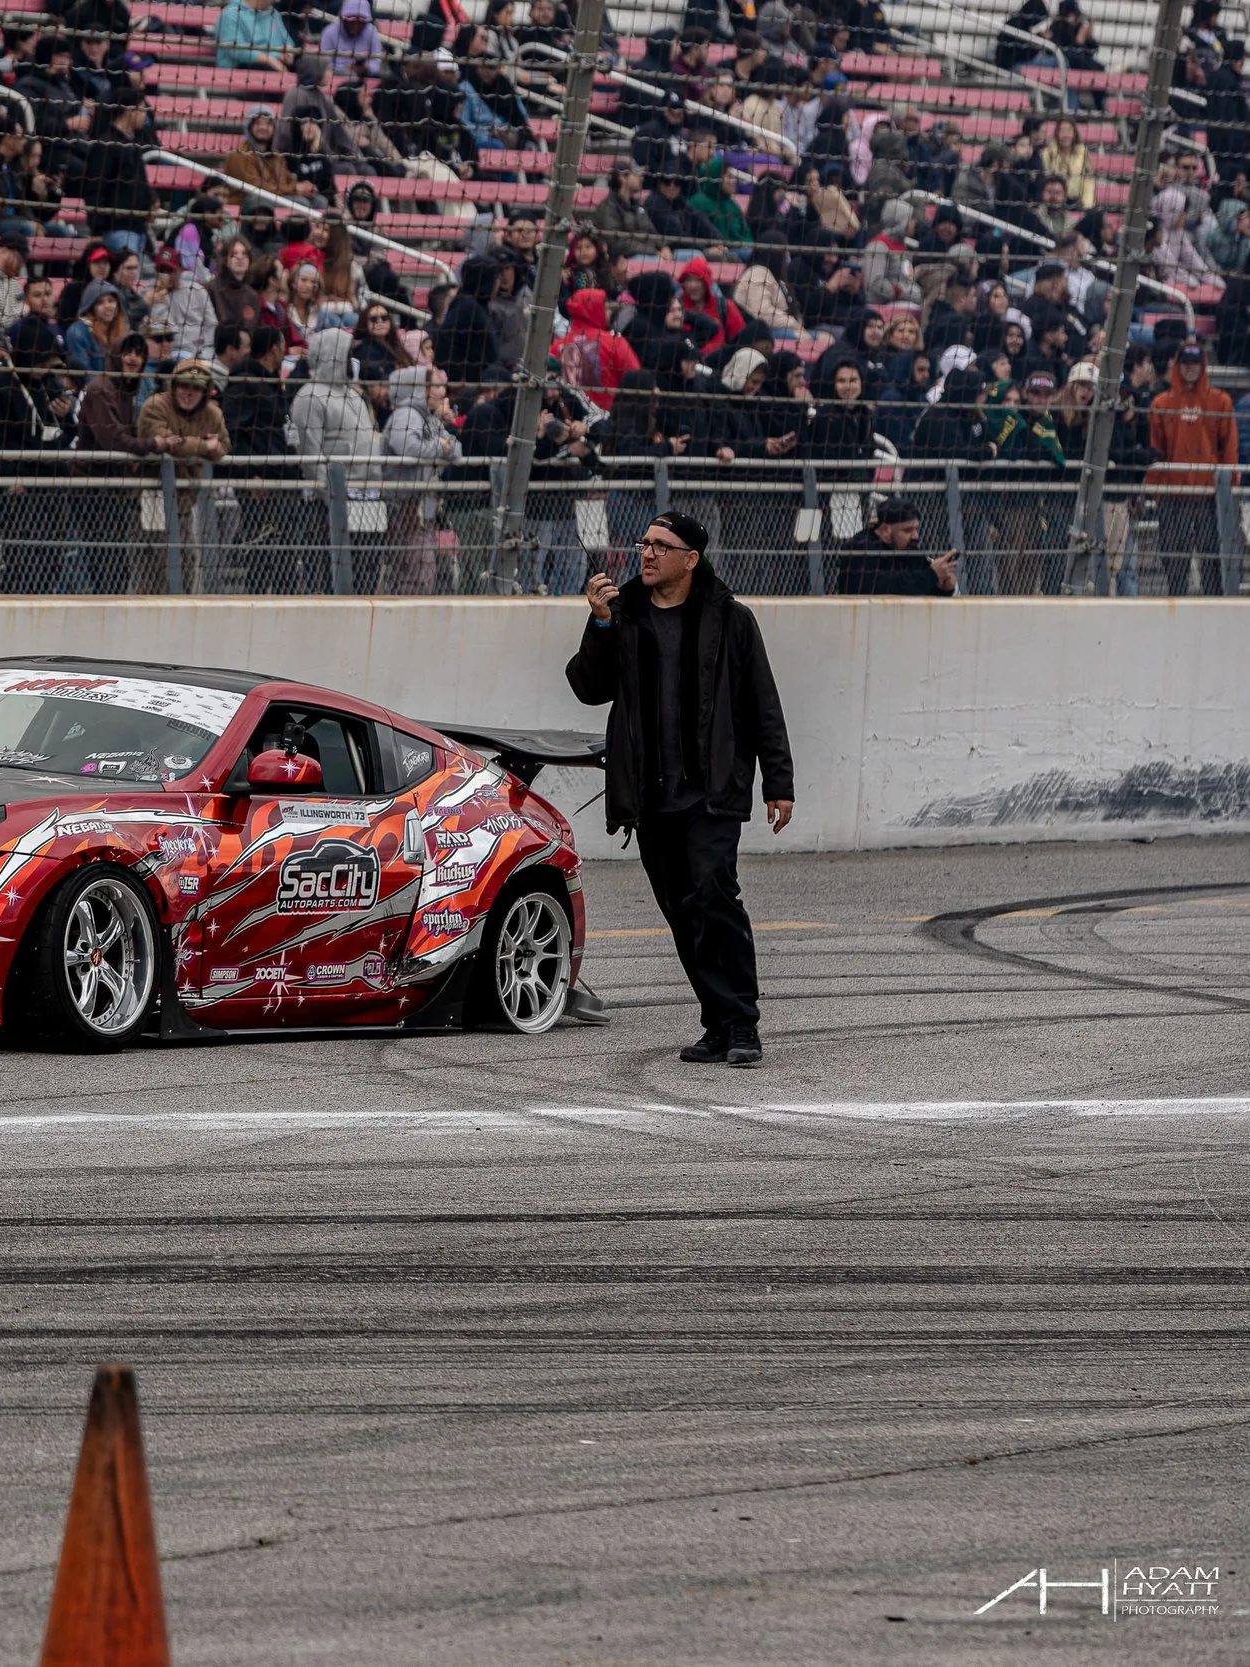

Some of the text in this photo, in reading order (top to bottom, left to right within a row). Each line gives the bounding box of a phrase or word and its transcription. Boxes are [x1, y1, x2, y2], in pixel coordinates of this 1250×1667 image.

[300, 809, 350, 820] ILLINGWORTH
[355, 811, 365, 821] 73
[435, 832, 470, 845] RAD
[280, 864, 377, 906] SacCity
[280, 898, 358, 909] AUTOPARTS.COM
[423, 909, 463, 932] spartan
[435, 920, 468, 936] graphics
[212, 970, 237, 979] SIMPSON
[316, 964, 346, 975] CROWN
